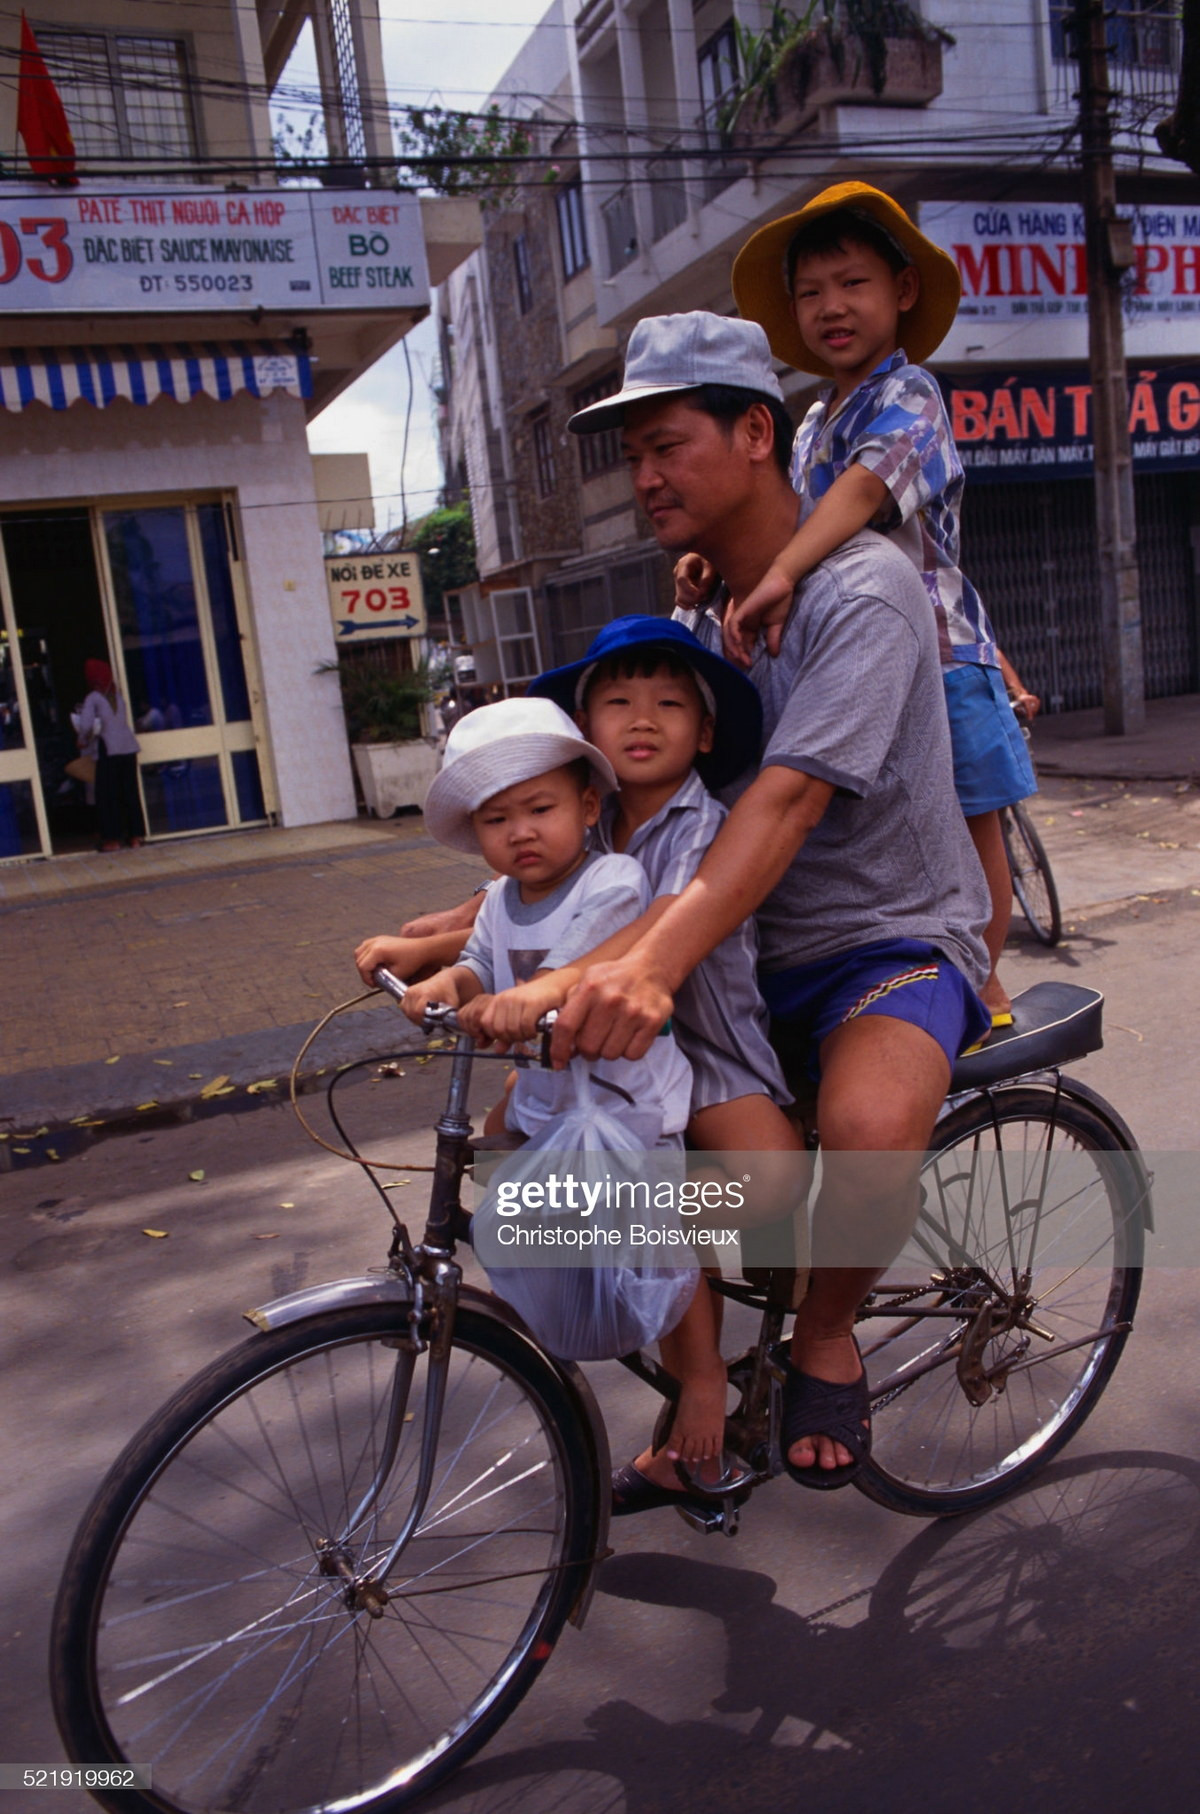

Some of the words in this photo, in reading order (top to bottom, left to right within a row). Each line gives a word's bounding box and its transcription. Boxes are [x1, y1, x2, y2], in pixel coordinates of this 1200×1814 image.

[160, 238, 209, 263] SAUCE
[174, 275, 254, 292] 550023
[328, 267, 361, 289] BEEF
[365, 265, 415, 288] STEAK
[951, 376, 1056, 441] BÁN
[1064, 370, 1161, 437] TẢ
[386, 562, 411, 578] XE
[341, 586, 411, 614] 703
